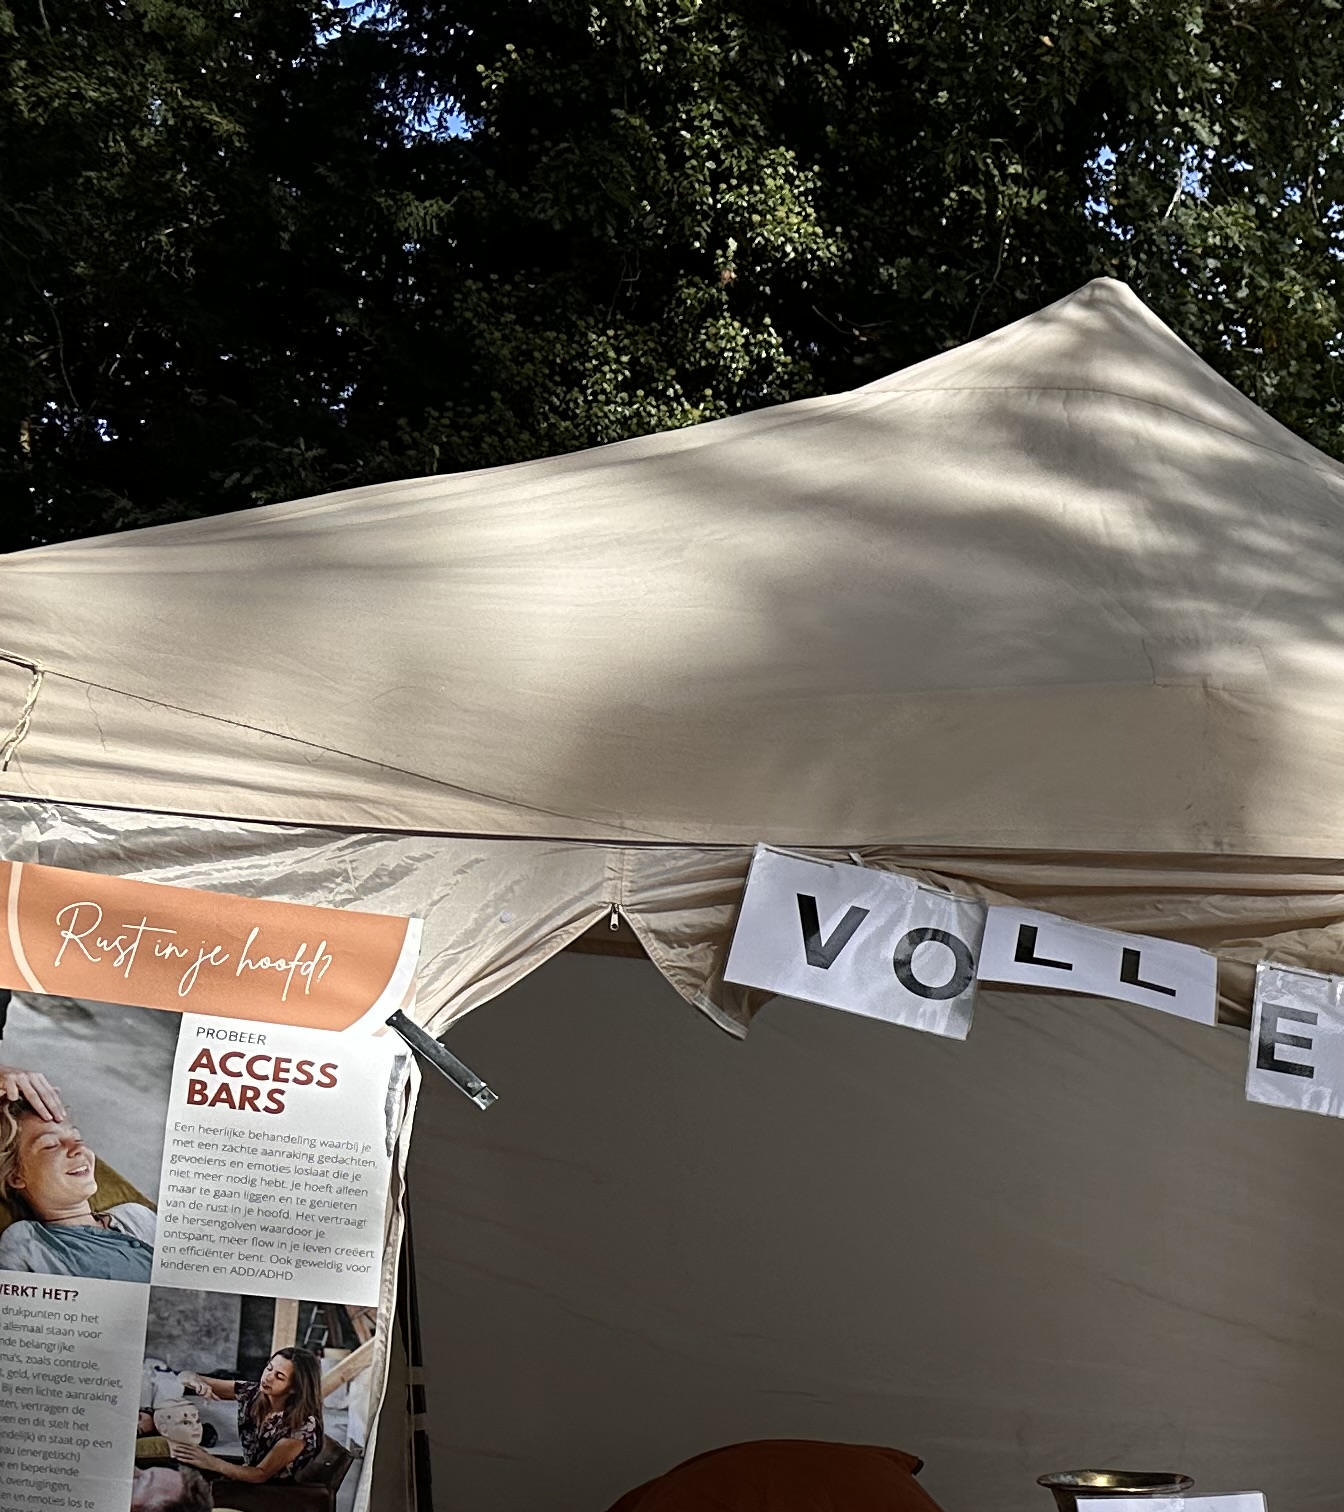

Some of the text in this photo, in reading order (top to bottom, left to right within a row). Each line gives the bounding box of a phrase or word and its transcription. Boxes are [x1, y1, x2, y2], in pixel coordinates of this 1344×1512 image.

[55, 901, 333, 1001] Rust in je hoofd?
[196, 1026, 267, 1045] PROBEER
[188, 1047, 339, 1088] ACCESS
[187, 1078, 286, 1114] BARS
[172, 1138, 194, 1148] met
[197, 1141, 218, 1150] een
[222, 1144, 258, 1155] zachte
[261, 1148, 314, 1163] aanraking
[175, 1122, 371, 1154] Een heerlijke behandeling waarbij je
[170, 1154, 361, 1183] gevoelens en emoties loslaat die je
[170, 1168, 190, 1178] niet
[194, 1171, 222, 1181] meer
[226, 1175, 257, 1187] nodig
[304, 1181, 332, 1194] hoeft
[336, 1186, 368, 1197] alleen
[168, 1184, 357, 1211] maar te gaan liggen en te genieten
[165, 1213, 325, 1240] de hersengolven waardoor je
[166, 1199, 185, 1208] van
[189, 1200, 202, 1210] de
[206, 1203, 228, 1213] rust
[231, 1204, 241, 1214] in
[243, 1206, 254, 1217] je
[296, 1211, 315, 1221] Het
[318, 1216, 368, 1229] vertraagt
[219, 1235, 248, 1245] meer
[252, 1236, 274, 1248] flow
[277, 1240, 287, 1250] in
[289, 1241, 299, 1253] je
[303, 1242, 331, 1254] leven
[161, 1259, 294, 1281] kinderen en ADD/ADHD
[270, 1255, 292, 1265] Ook
[295, 1259, 342, 1273] geweldig
[346, 1264, 371, 1273] voor
[0, 1283, 79, 1301] ERKT HET?
[2, 1305, 99, 1324] drukpunten op het
